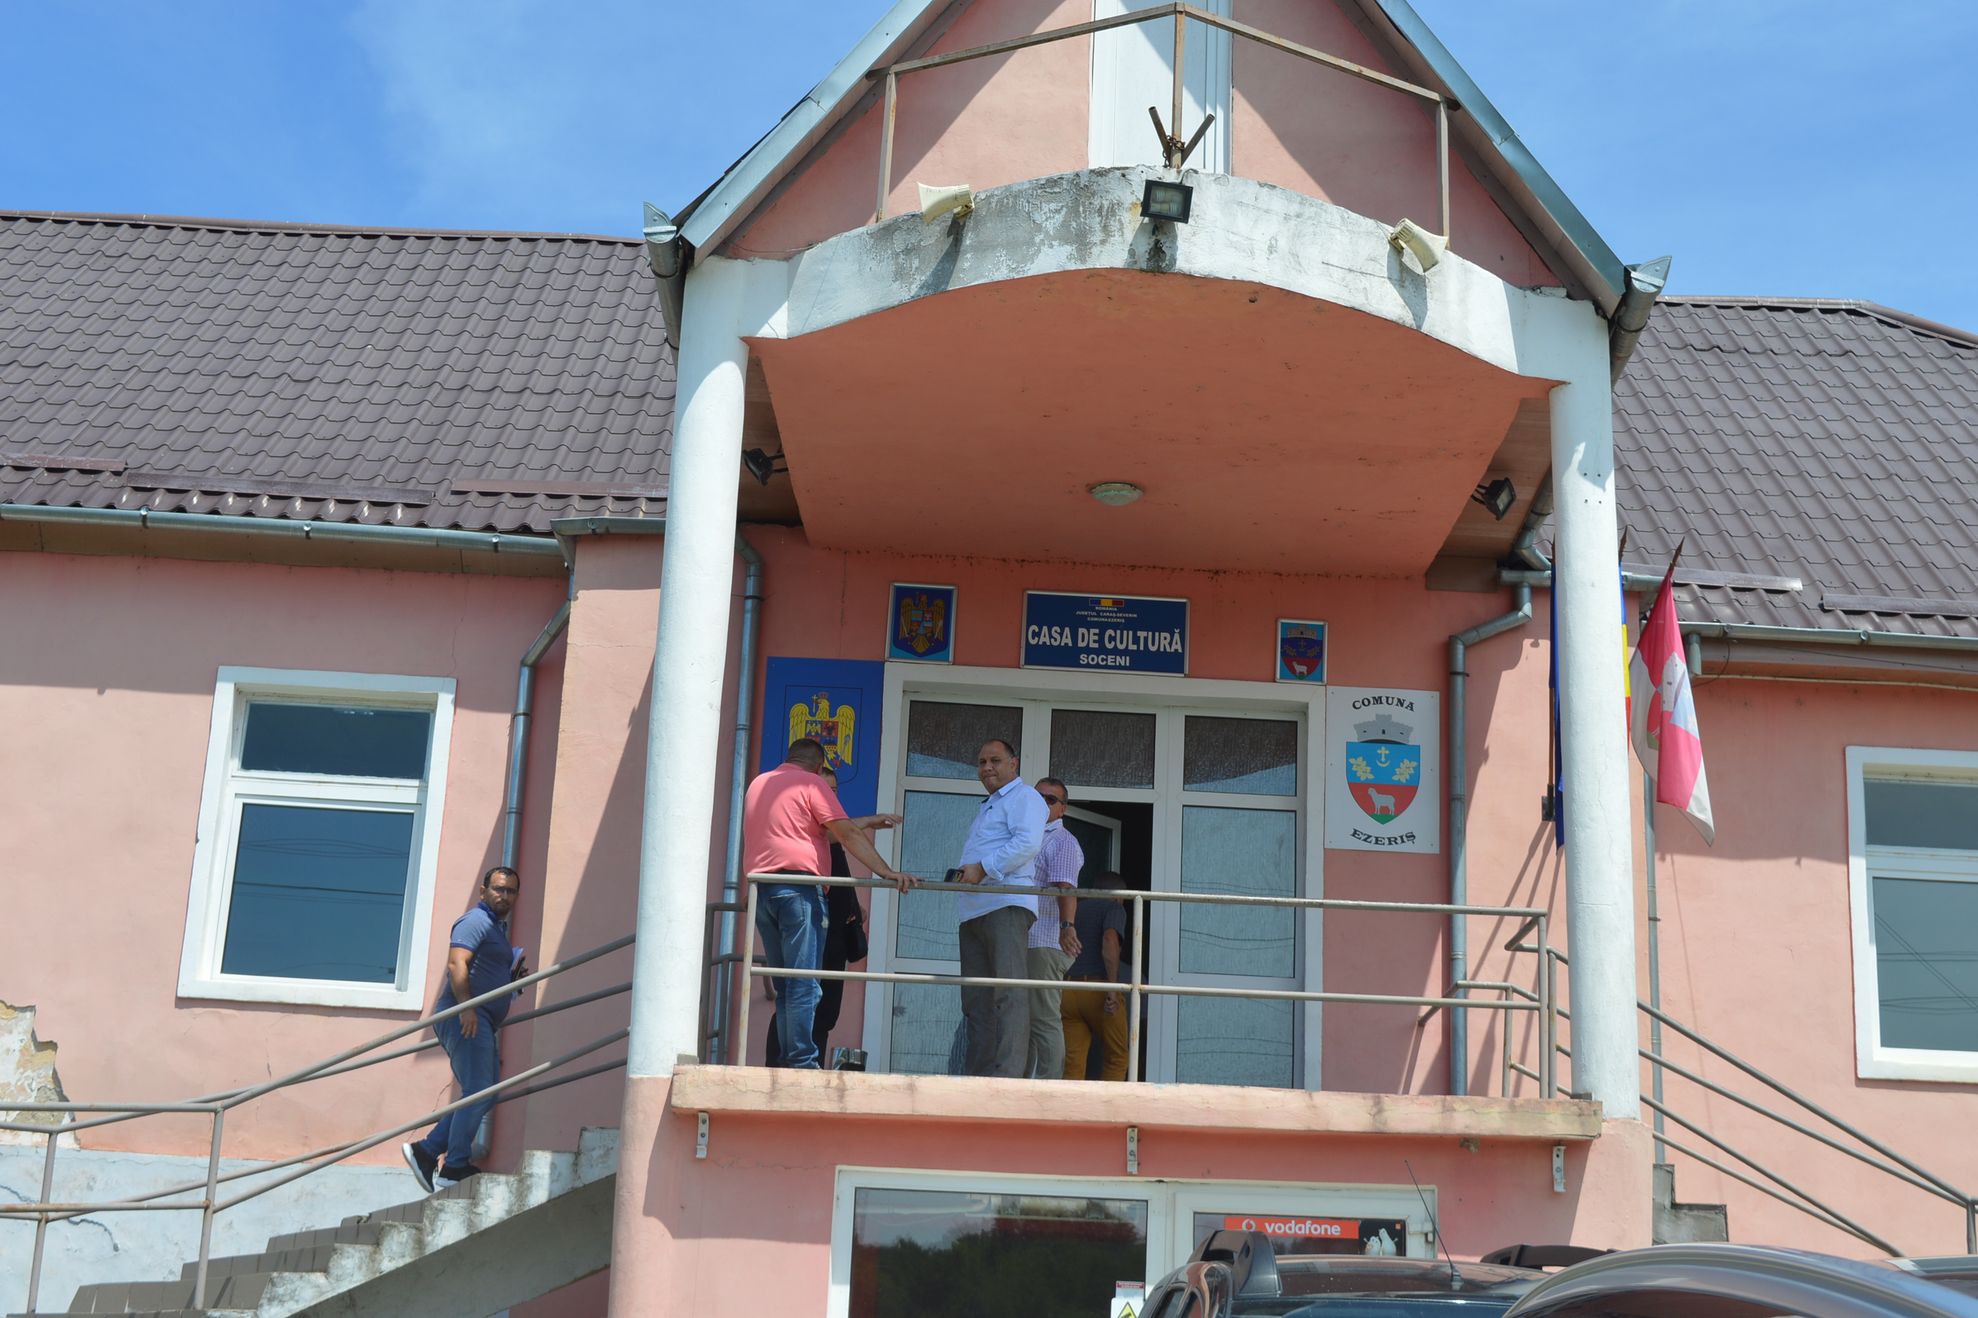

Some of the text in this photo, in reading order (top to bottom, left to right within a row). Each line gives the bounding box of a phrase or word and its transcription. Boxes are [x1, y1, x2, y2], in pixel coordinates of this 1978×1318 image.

[1028, 624, 1183, 653] CASA DE CULTURĂ
[1079, 654, 1130, 666] SOCENI
[1352, 696, 1415, 712] COMUNA
[1350, 828, 1416, 845] EZERIȘ
[1264, 1220, 1341, 1236] vodafone
